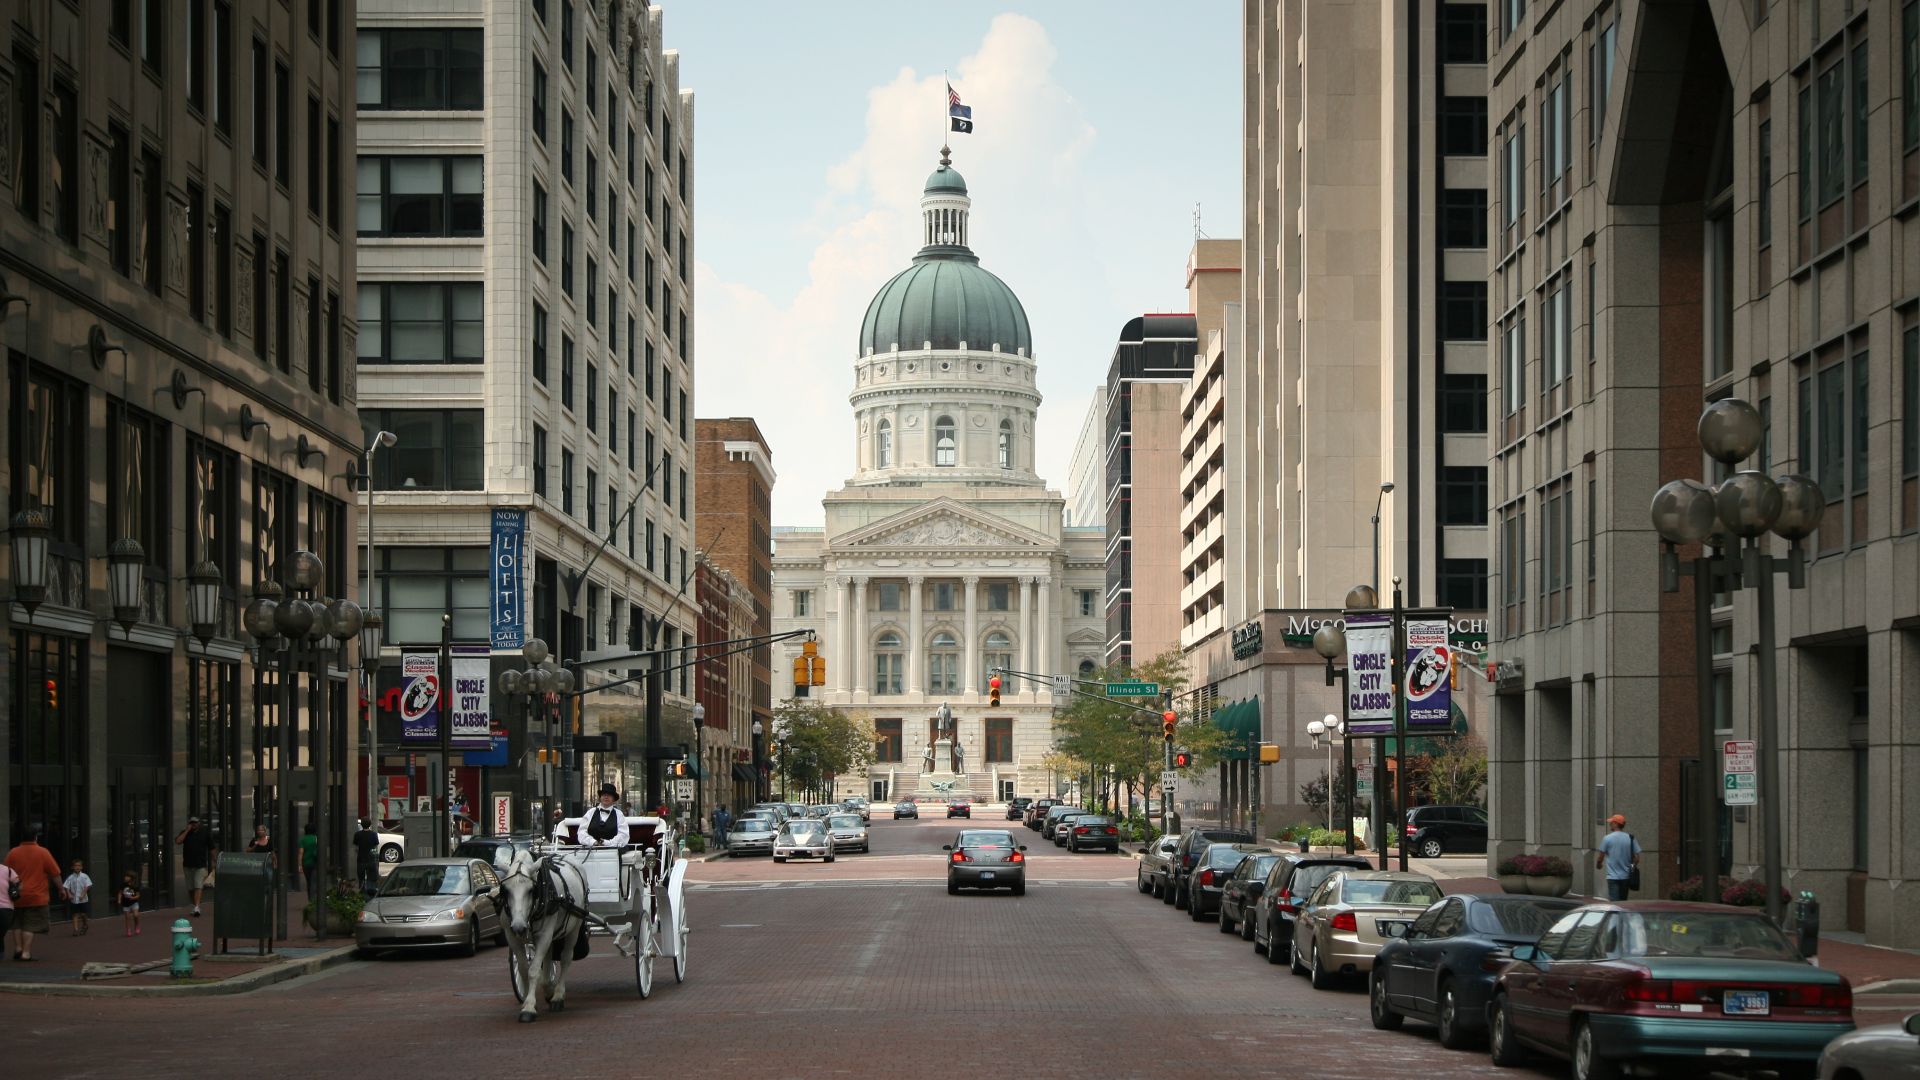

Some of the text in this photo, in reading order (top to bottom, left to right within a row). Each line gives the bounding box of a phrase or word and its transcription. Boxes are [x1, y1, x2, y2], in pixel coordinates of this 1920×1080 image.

[496, 511, 520, 520] NOW
[500, 536, 513, 623] LOFTS
[496, 632, 519, 640] CALL
[1353, 653, 1386, 670] CIRCLE
[456, 679, 485, 693] CIRCLE
[1055, 675, 1069, 683] WAIT
[1360, 673, 1381, 690] CITY
[1109, 686, 1141, 694] Illinois
[461, 696, 480, 710] CITY
[1350, 692, 1391, 710] CLASSIC
[1433, 708, 1449, 716] City
[453, 712, 488, 727] CLASSIC
[1727, 777, 1734, 788] 2
